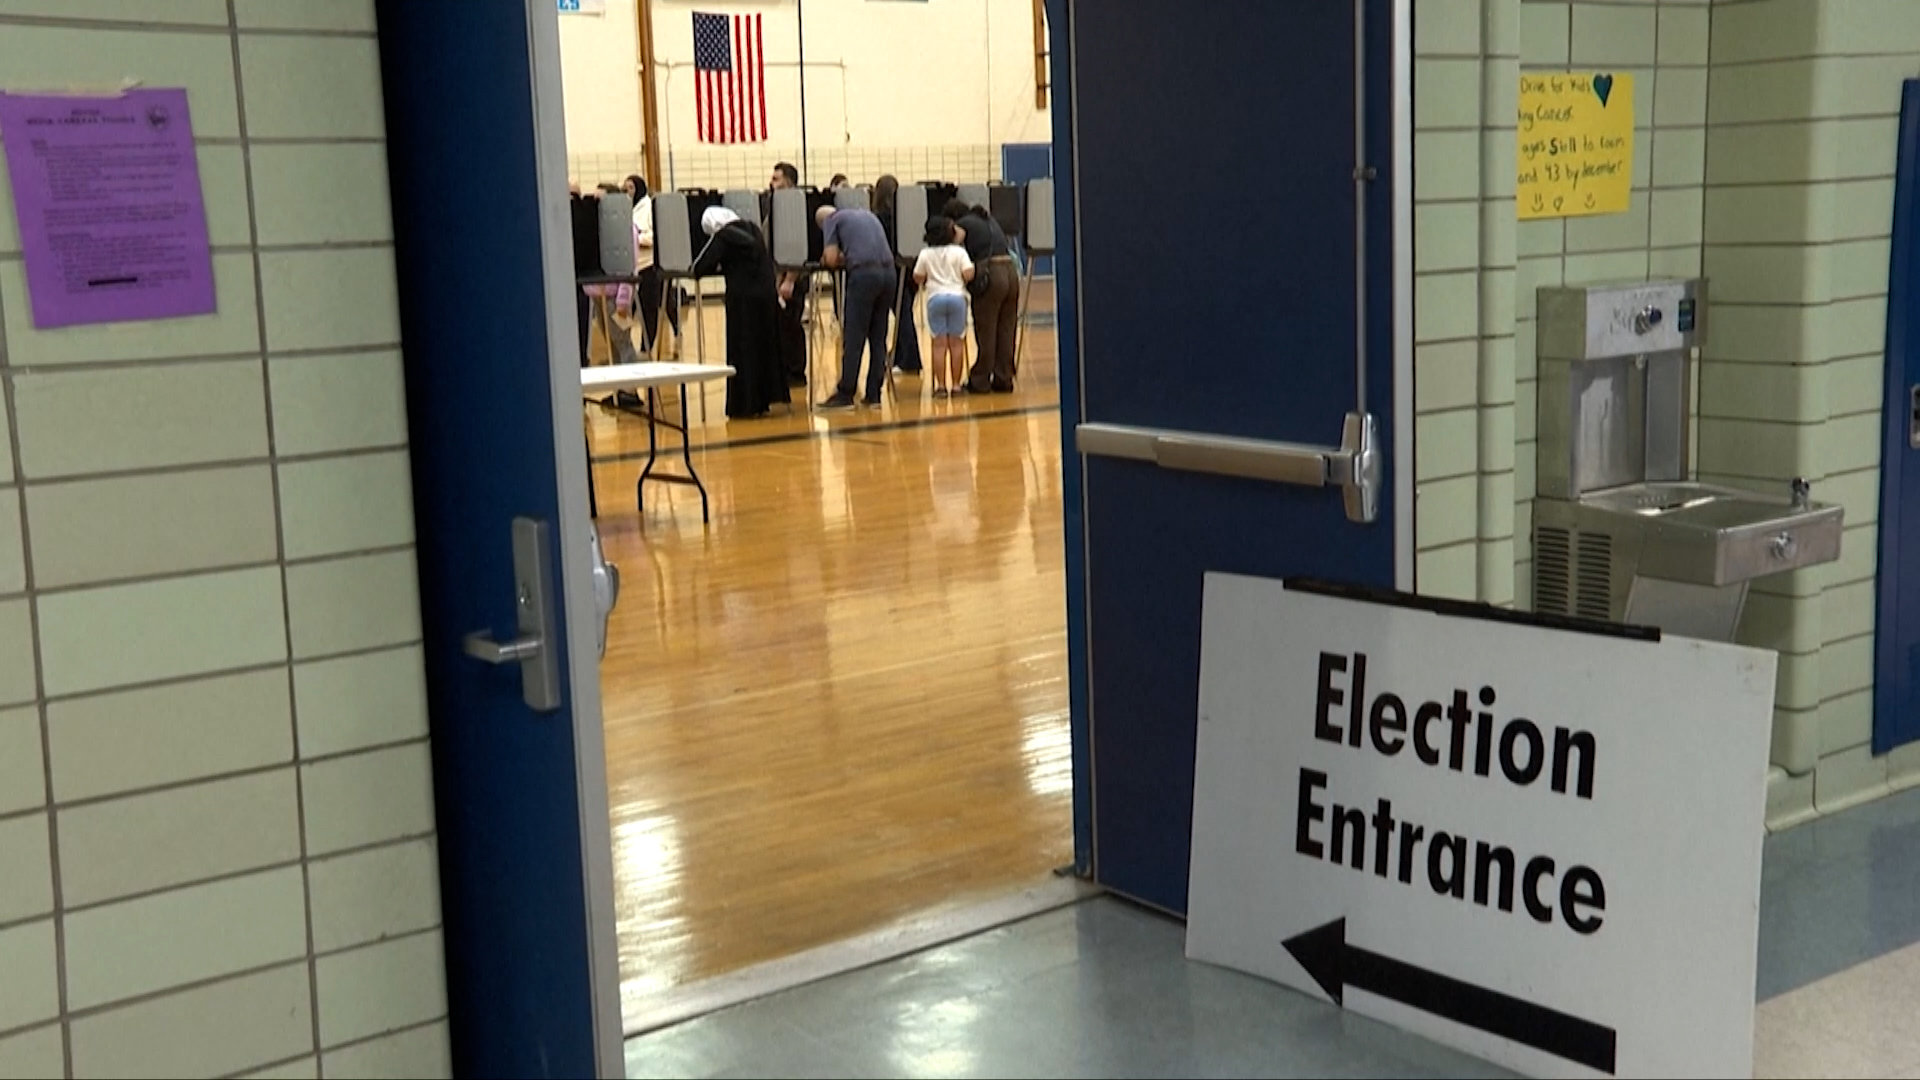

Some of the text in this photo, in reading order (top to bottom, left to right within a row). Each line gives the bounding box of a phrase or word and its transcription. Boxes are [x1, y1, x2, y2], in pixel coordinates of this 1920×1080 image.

[1551, 76, 1563, 93] for
[1583, 134, 1595, 151] to
[1545, 163, 1560, 181] 43
[1565, 163, 1579, 191] by
[1314, 651, 1597, 800] Election
[1295, 767, 1607, 935] Entrance
